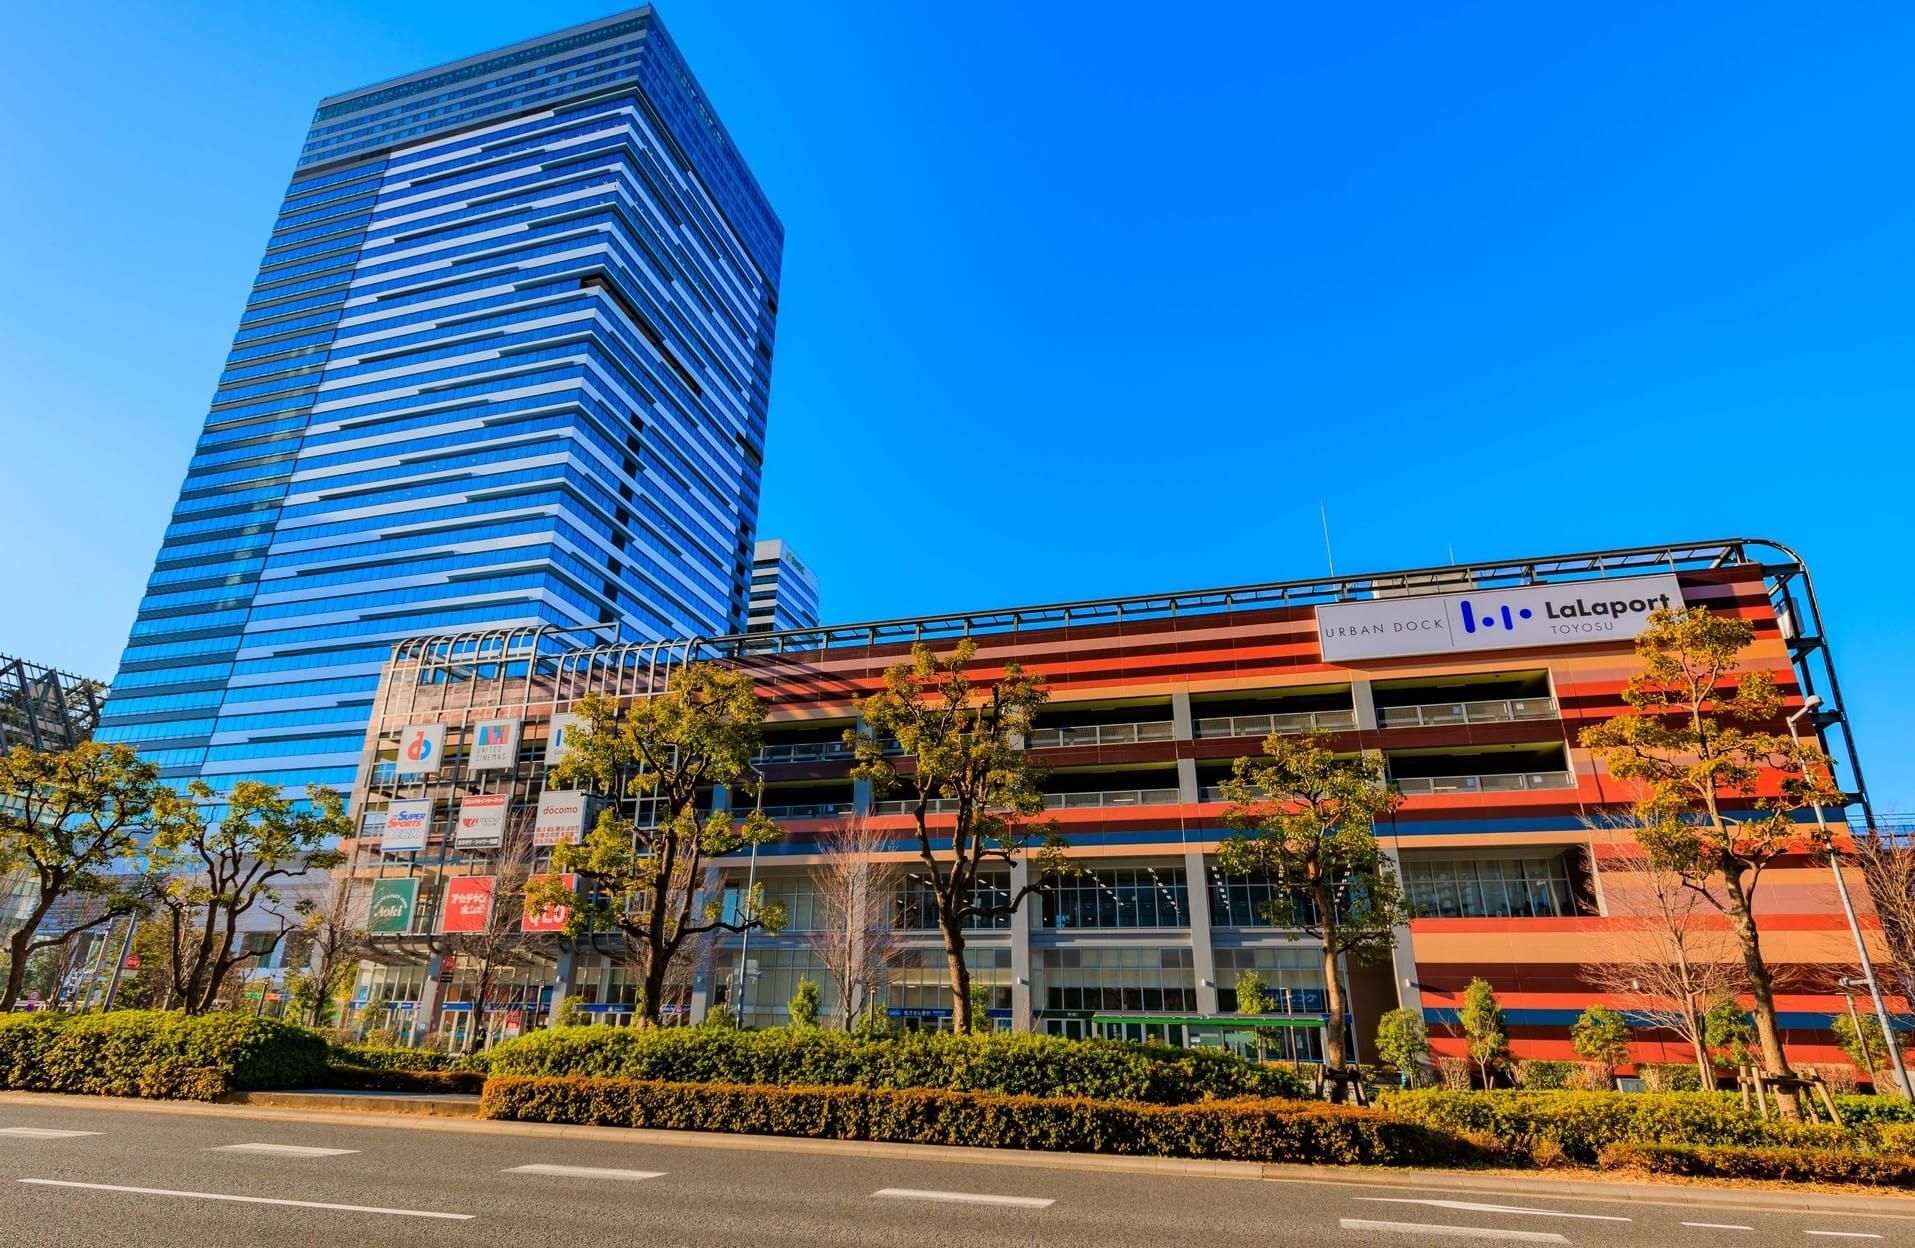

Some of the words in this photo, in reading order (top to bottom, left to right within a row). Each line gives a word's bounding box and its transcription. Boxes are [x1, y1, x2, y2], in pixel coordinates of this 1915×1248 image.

[1545, 594, 1669, 619] LaLaport
[1325, 623, 1384, 638] URBAN
[1393, 619, 1443, 633] DOCK
[1550, 621, 1614, 635] TOYOSU
[398, 810, 426, 820] SUPER
[543, 806, 578, 815] docomo
[387, 818, 422, 828] SPORTS
